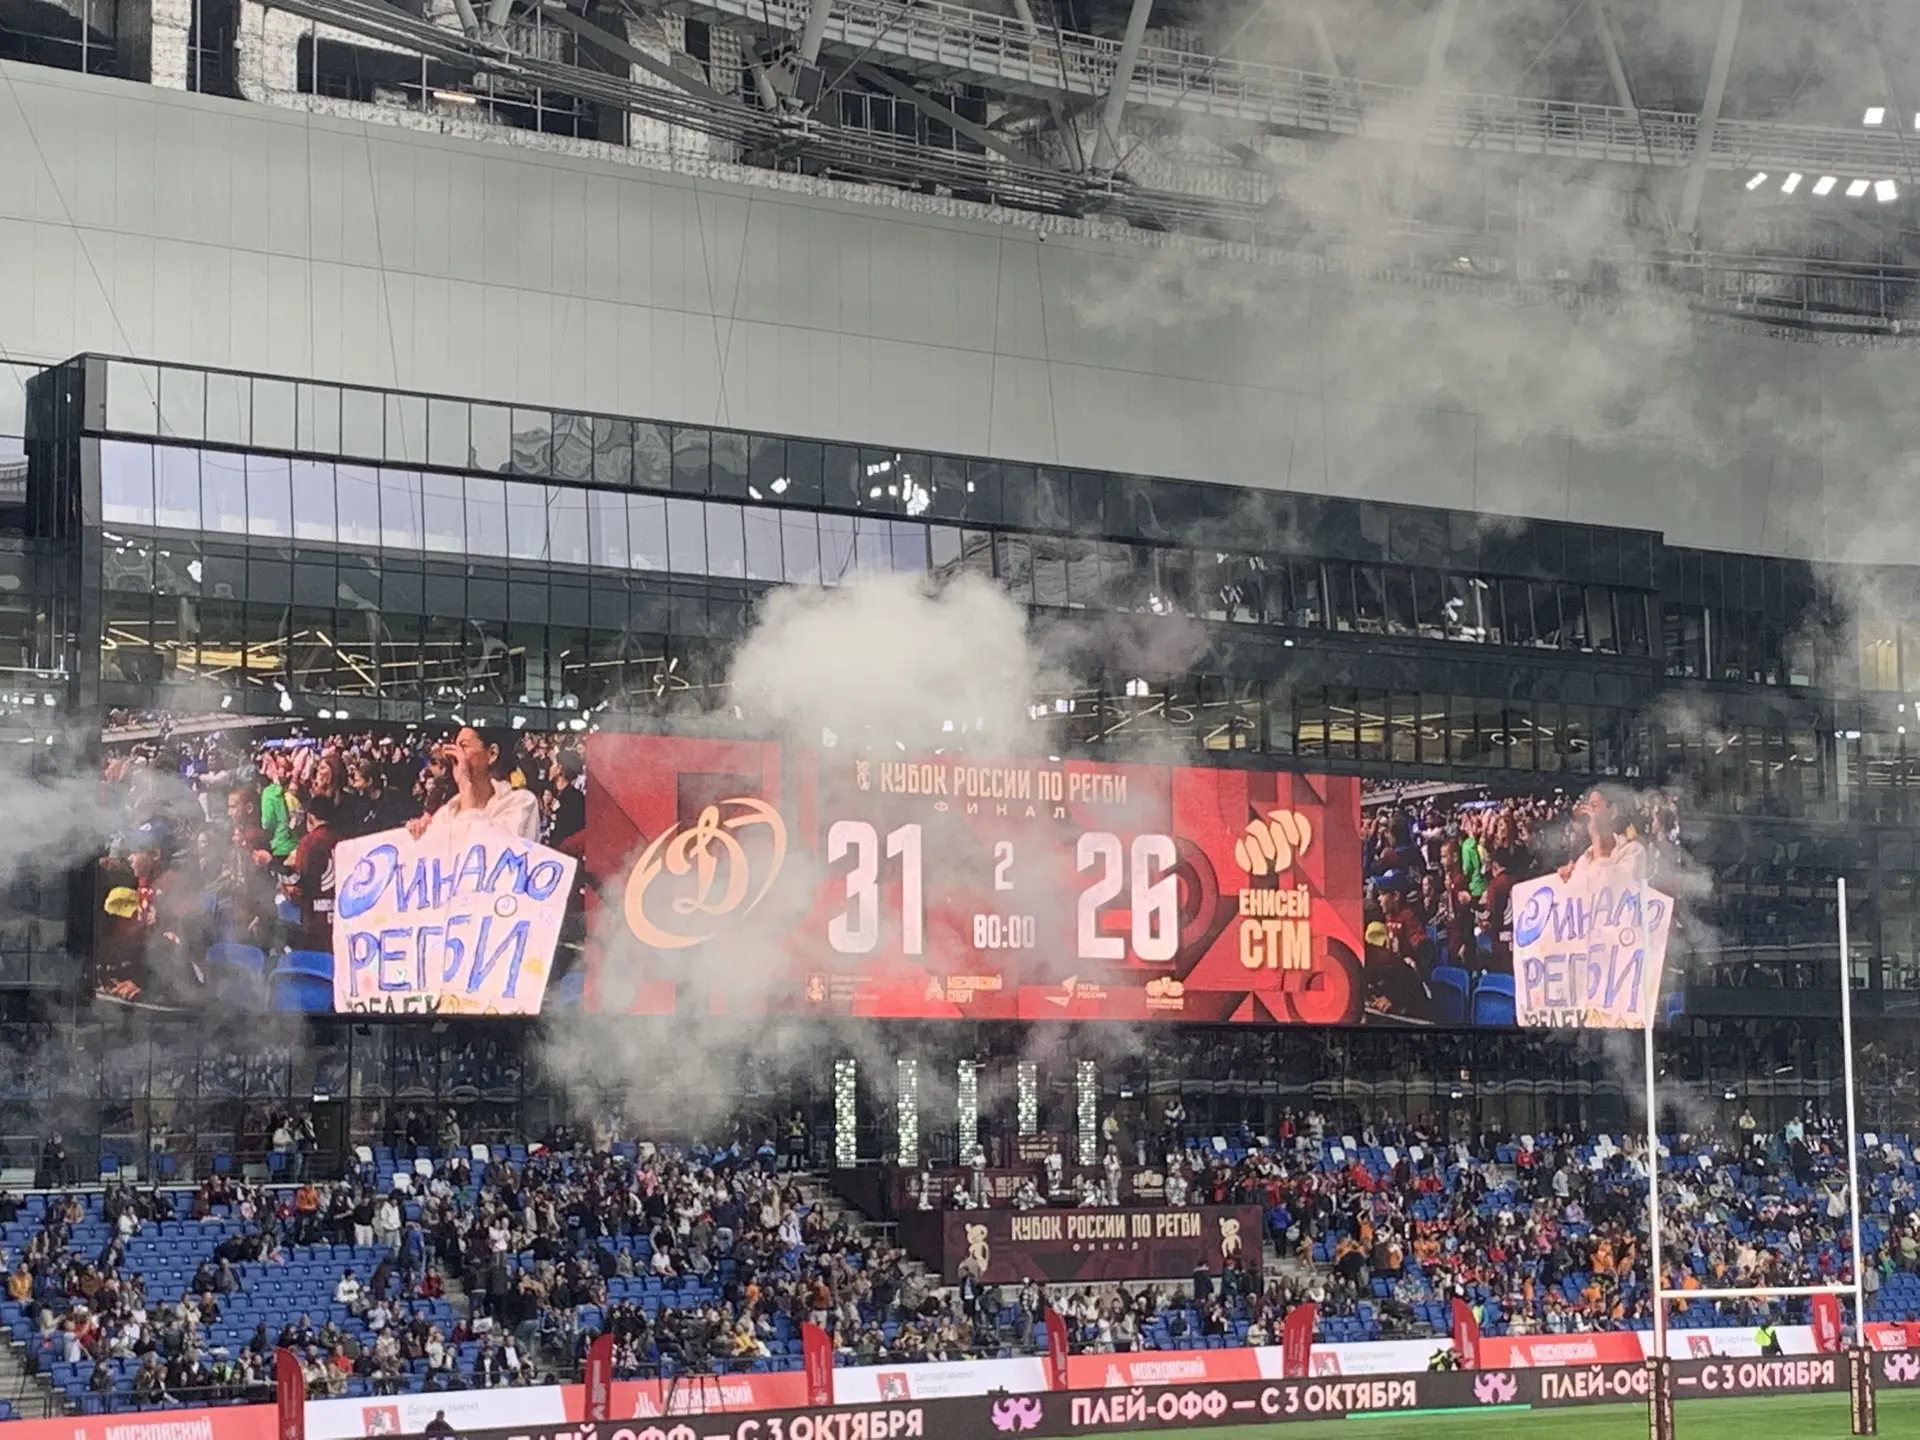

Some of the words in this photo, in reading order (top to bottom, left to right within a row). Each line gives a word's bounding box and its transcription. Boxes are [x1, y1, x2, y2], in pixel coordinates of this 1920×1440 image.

[881, 763, 948, 795] КУБОК
[954, 766, 1030, 799] РОССИИ
[1038, 770, 1063, 801] ПО
[1069, 773, 1127, 804] РЕГБИ
[934, 800, 1065, 819] ФИНАЛ
[828, 820, 922, 954] 31
[994, 841, 1015, 890] 2
[1076, 831, 1179, 961] 26
[1239, 884, 1309, 917] ЕНИСЕЙ
[973, 914, 1035, 949] 80:00
[1240, 919, 1311, 969] СТМ
[347, 914, 530, 998] РЕГБИ
[1522, 944, 1646, 1012] РЕГБИ
[1011, 1216, 1062, 1241] КУБОК
[1067, 1214, 1126, 1240] РОССИИ
[1132, 1213, 1151, 1237] ПО
[1156, 1212, 1201, 1237] РЕГБИ
[1541, 1365, 1649, 1399] ПЛЕЙ-ОФ
[1701, 1365, 1718, 1390] С
[1722, 1364, 1735, 1390] 3
[1739, 1360, 1834, 1388] ОКТЯБРЯ
[767, 1418, 783, 1440] 3
[789, 1408, 923, 1440] ОКТЯБРЯ
[1071, 1388, 1227, 1426] ПЛЕЙ-ОФФ
[1261, 1387, 1280, 1414] С
[1284, 1387, 1298, 1413] 3
[1304, 1380, 1416, 1411] ОКТЯБРЯ
